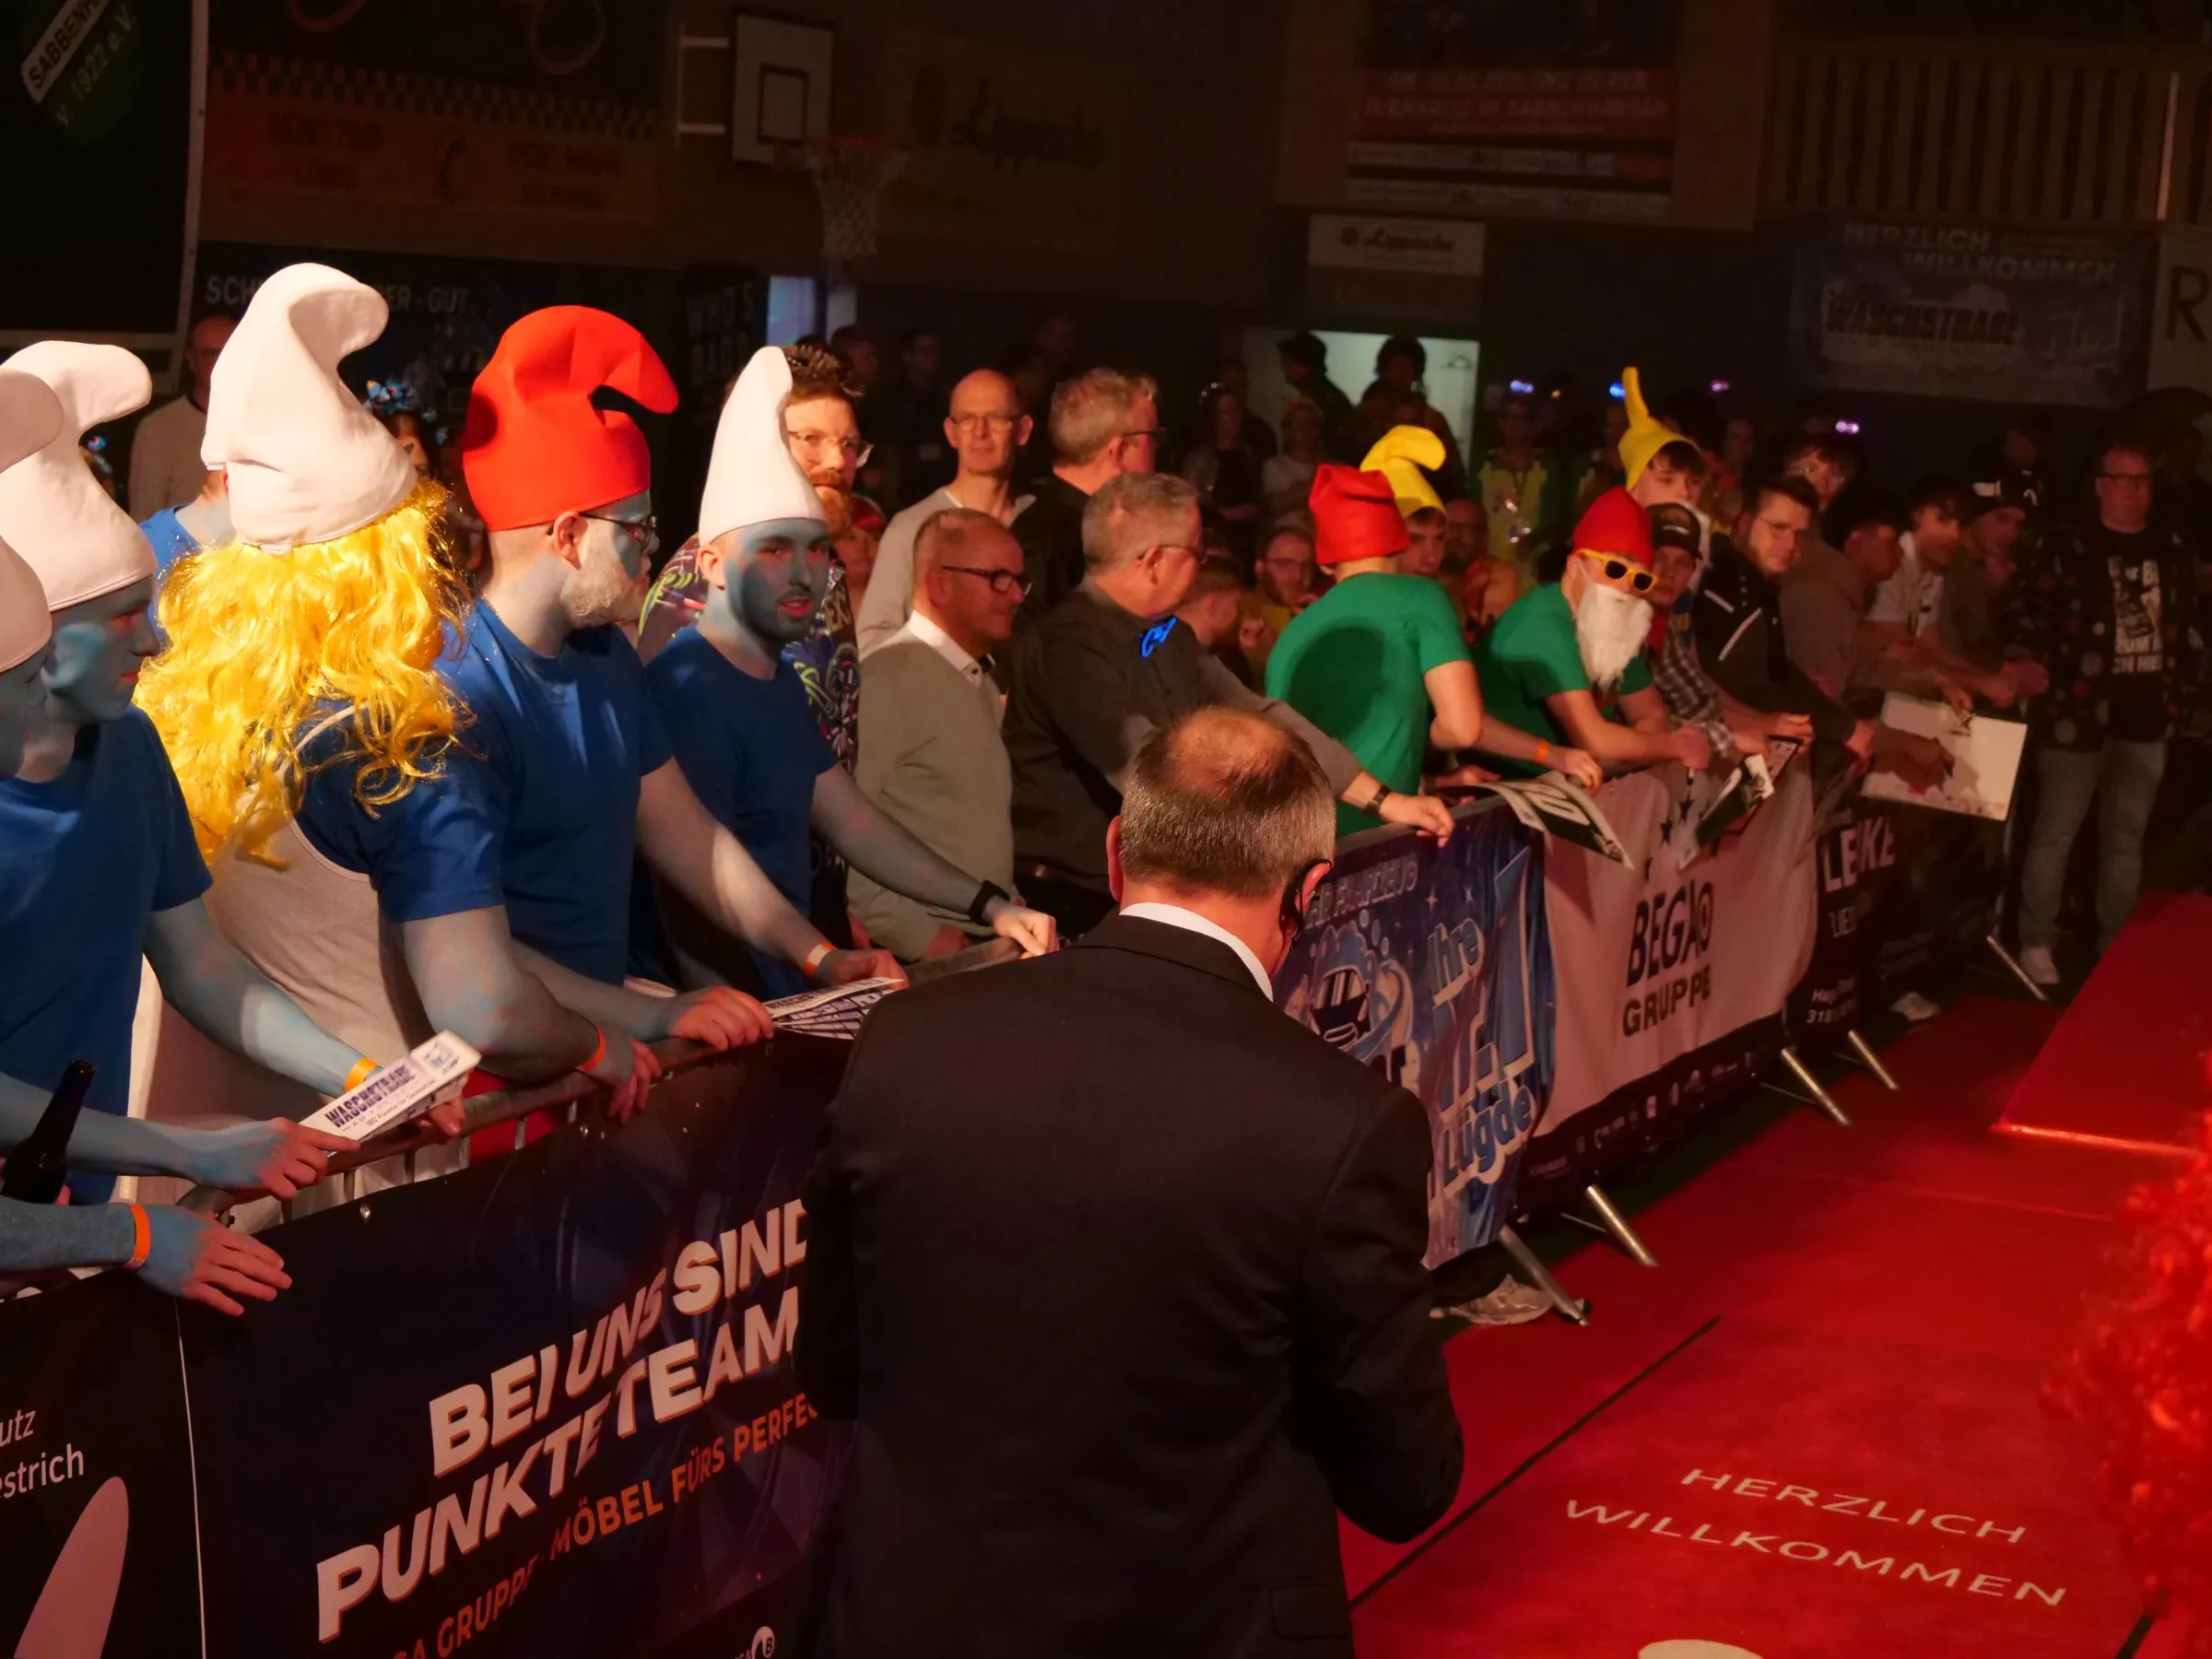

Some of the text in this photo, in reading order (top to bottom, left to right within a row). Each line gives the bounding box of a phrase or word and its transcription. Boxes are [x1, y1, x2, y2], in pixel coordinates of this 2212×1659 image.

[70, 42, 109, 102] 1922
[1844, 223, 1990, 251] HERZLICH
[1903, 252, 2115, 283] WILLKOMMEN
[1429, 920, 1482, 1006] Ihre
[1623, 963, 1710, 1037] GRUPPE
[1440, 1080, 1534, 1187] Lügde
[429, 1343, 559, 1478] BEI
[565, 1267, 666, 1399] UNS
[316, 1393, 611, 1644] PUNKTE
[550, 1480, 664, 1562] MÖBEL
[671, 1436, 725, 1494] FÜRS
[1681, 1469, 2026, 1543] HERZLICH
[1567, 1500, 2065, 1606] WILLKOMMEN
